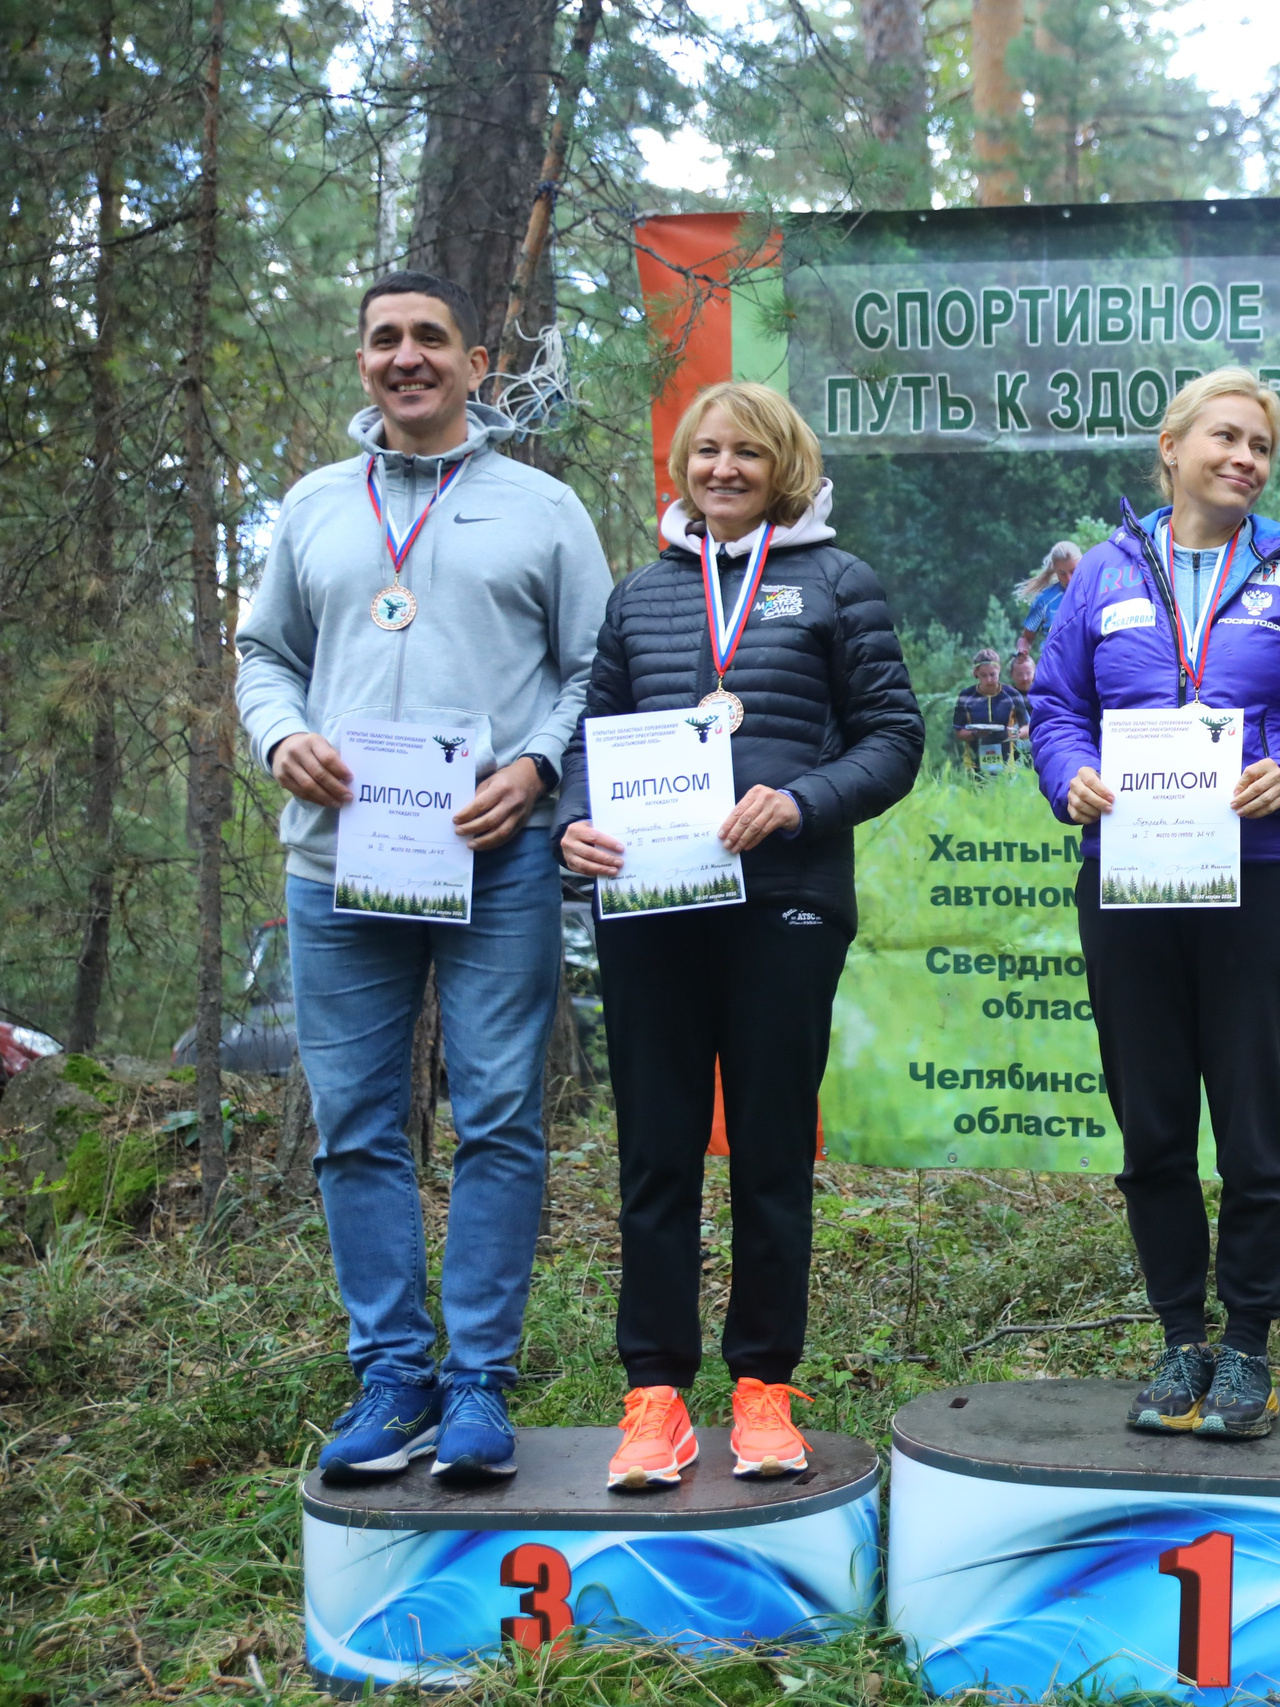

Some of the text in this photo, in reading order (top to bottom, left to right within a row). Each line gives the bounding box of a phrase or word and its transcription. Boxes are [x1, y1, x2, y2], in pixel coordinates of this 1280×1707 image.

[854, 282, 1262, 350] СПОРТИВНОЕ
[825, 373, 975, 435] ПУТЬ
[995, 371, 1031, 432] К
[359, 785, 451, 809] ДИПЛОМ
[611, 773, 710, 801] ДИПЛОМ
[1120, 772, 1216, 791] ДИПЛОМ
[930, 885, 1078, 908] автоном
[925, 945, 1087, 982] Свердло
[982, 991, 1095, 1021] облас
[908, 1061, 1107, 1094] Челябинс
[953, 1105, 1106, 1138] область
[501, 1542, 575, 1660] 3
[1158, 1530, 1236, 1689] 1
